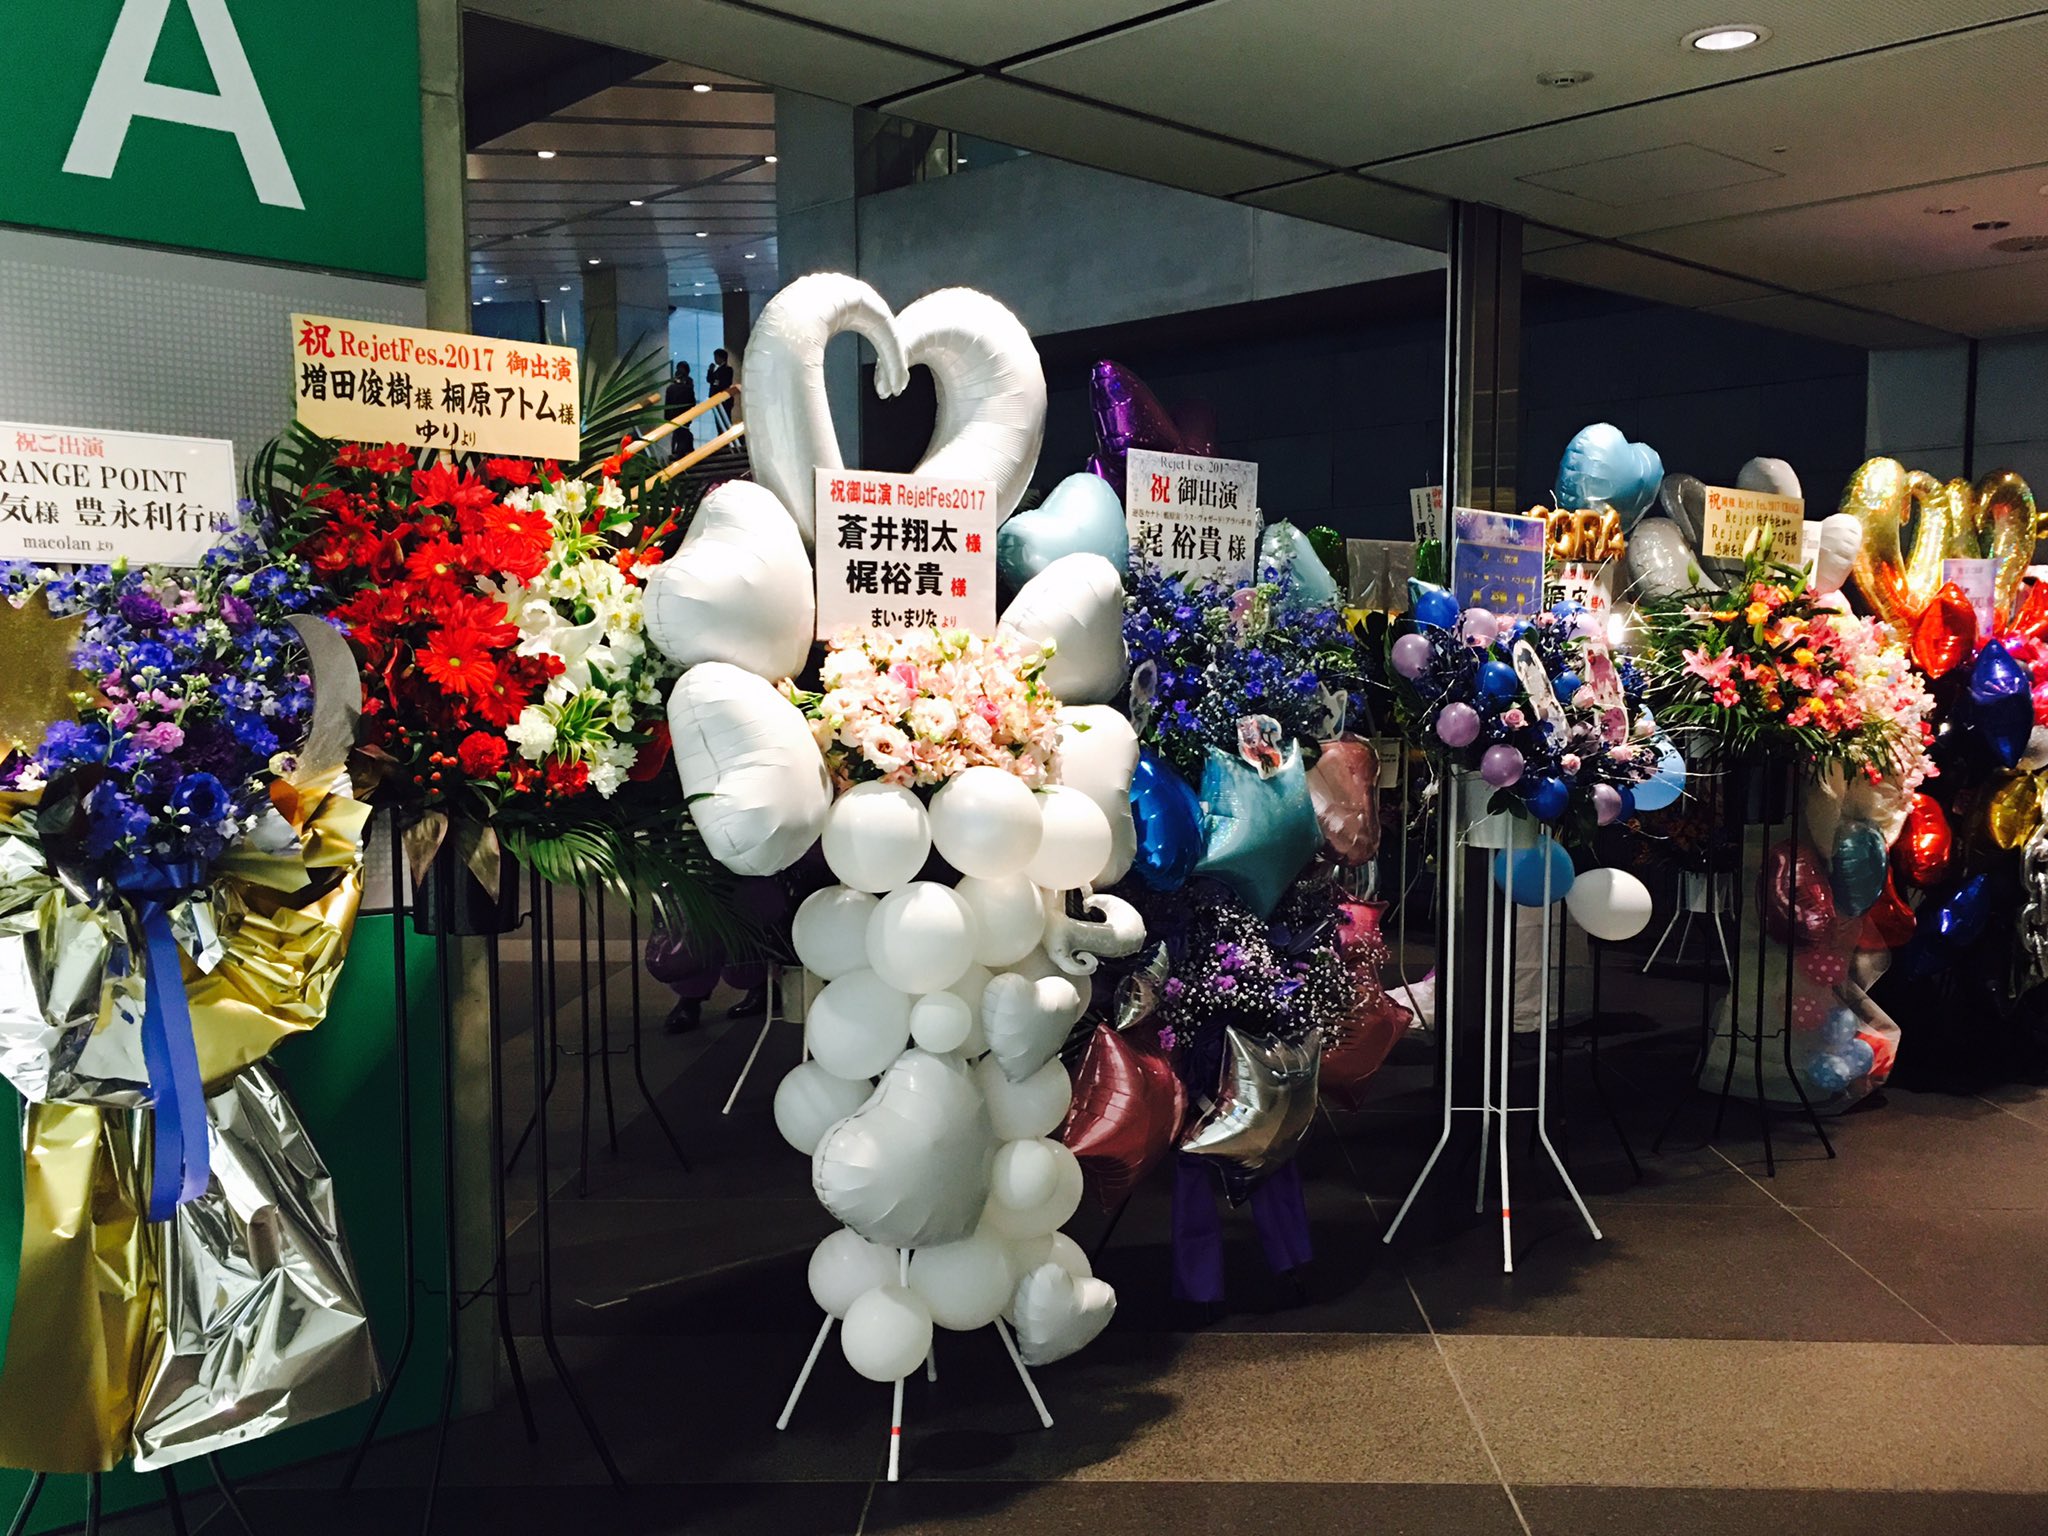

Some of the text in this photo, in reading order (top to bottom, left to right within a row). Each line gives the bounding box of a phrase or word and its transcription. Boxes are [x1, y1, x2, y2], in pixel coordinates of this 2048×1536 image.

[62, 0, 305, 210] A
[298, 319, 335, 359] 祝
[506, 350, 573, 383] 御出演
[16, 431, 105, 458] 祝ご出演
[100, 465, 187, 494] POINT
[830, 479, 892, 506] 祝御出演
[1151, 473, 1239, 510] 祝 御出演
[23, 535, 91, 551] macolan
